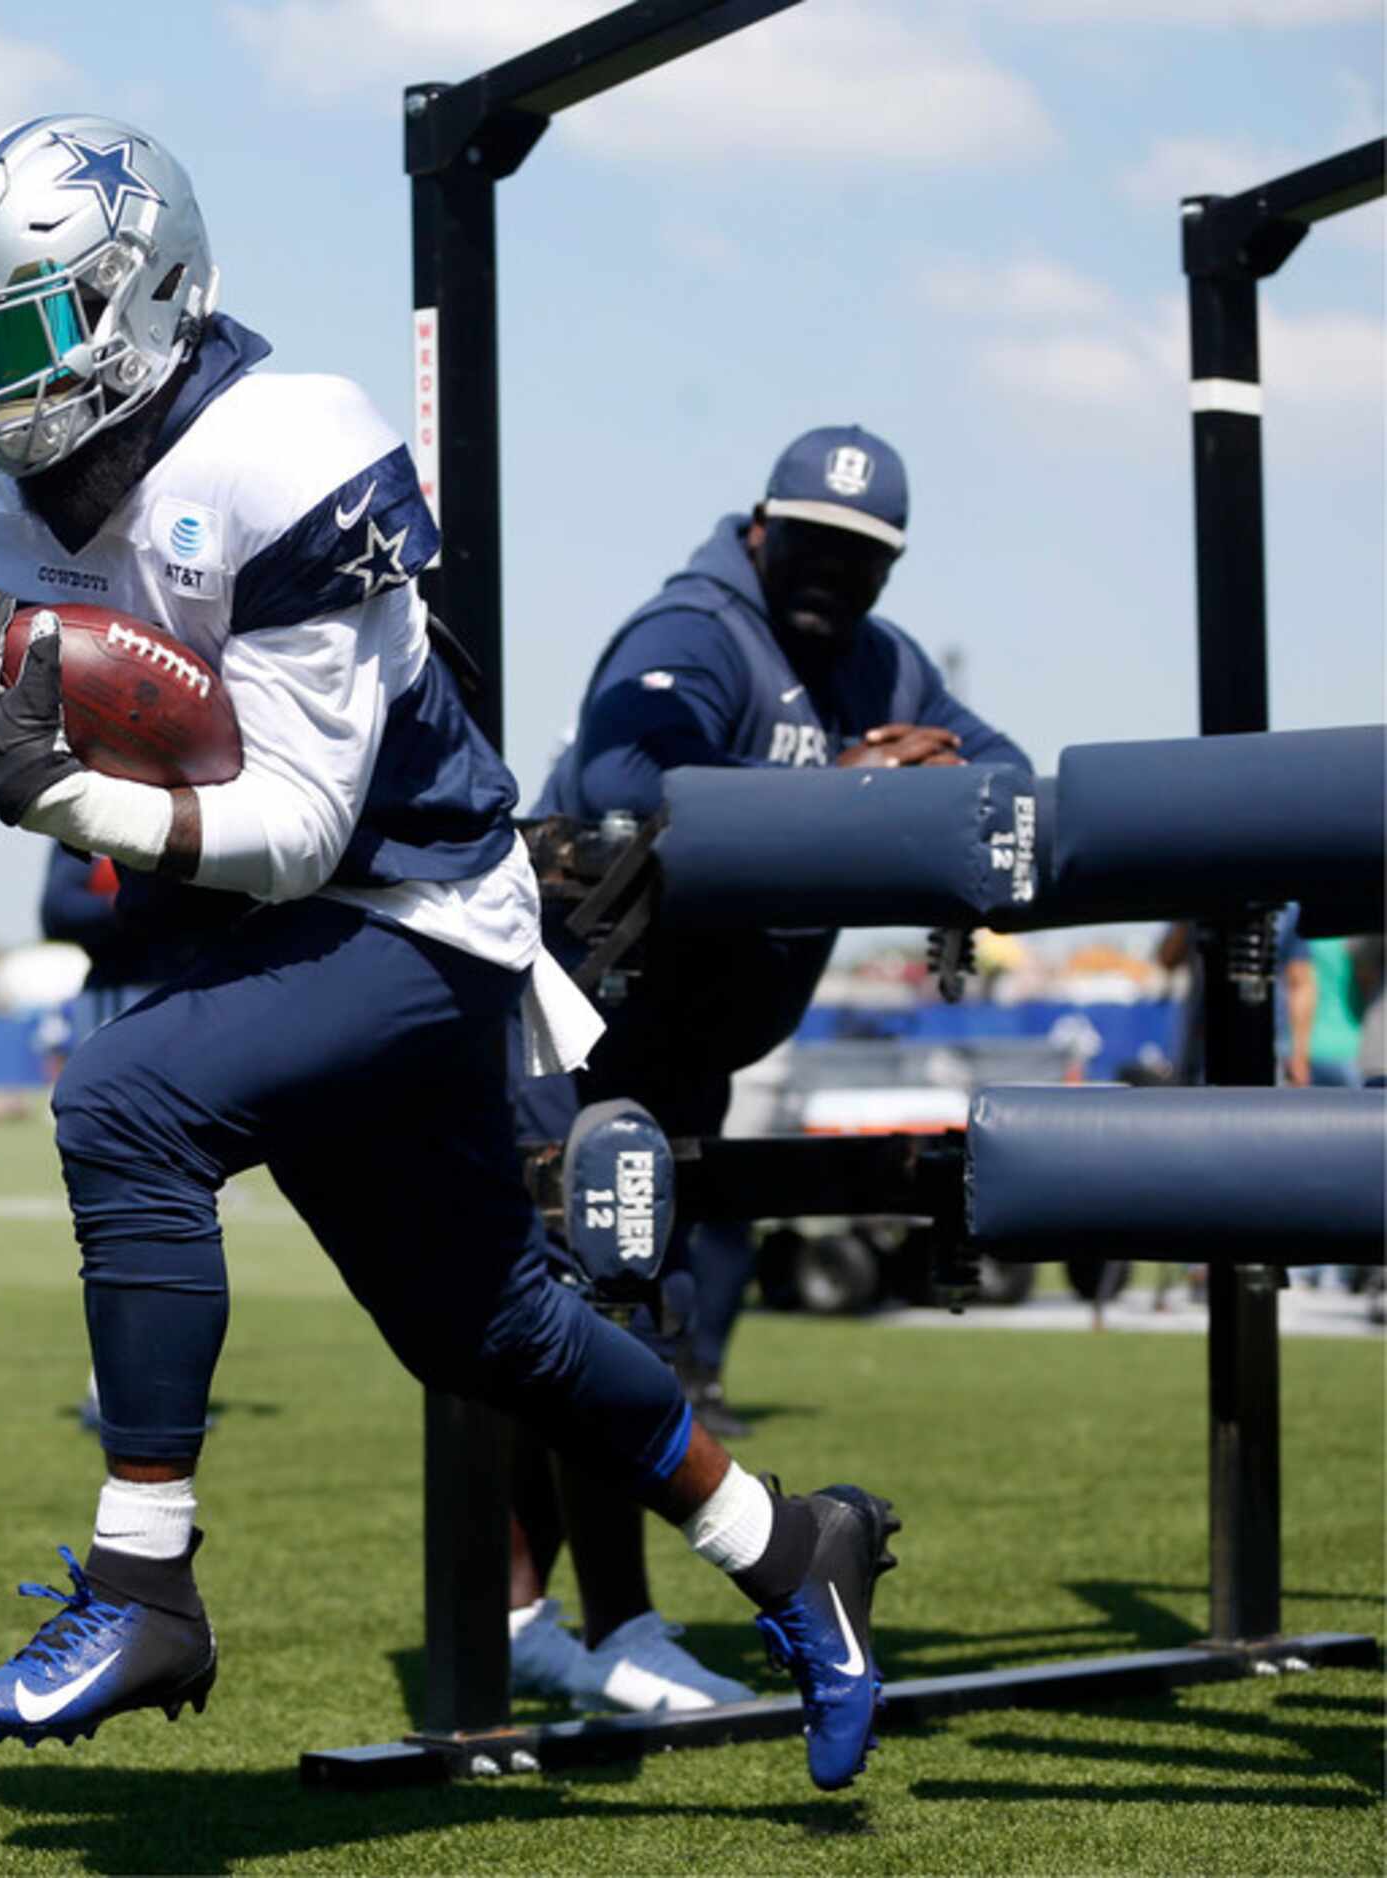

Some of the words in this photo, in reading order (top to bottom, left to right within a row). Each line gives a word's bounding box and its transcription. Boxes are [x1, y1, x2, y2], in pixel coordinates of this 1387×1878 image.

[37, 564, 109, 592] COWBOYS
[164, 563, 205, 588] AT&T
[990, 832, 1014, 870] 12
[585, 1189, 615, 1229] 12
[617, 1151, 654, 1261] FISHER
